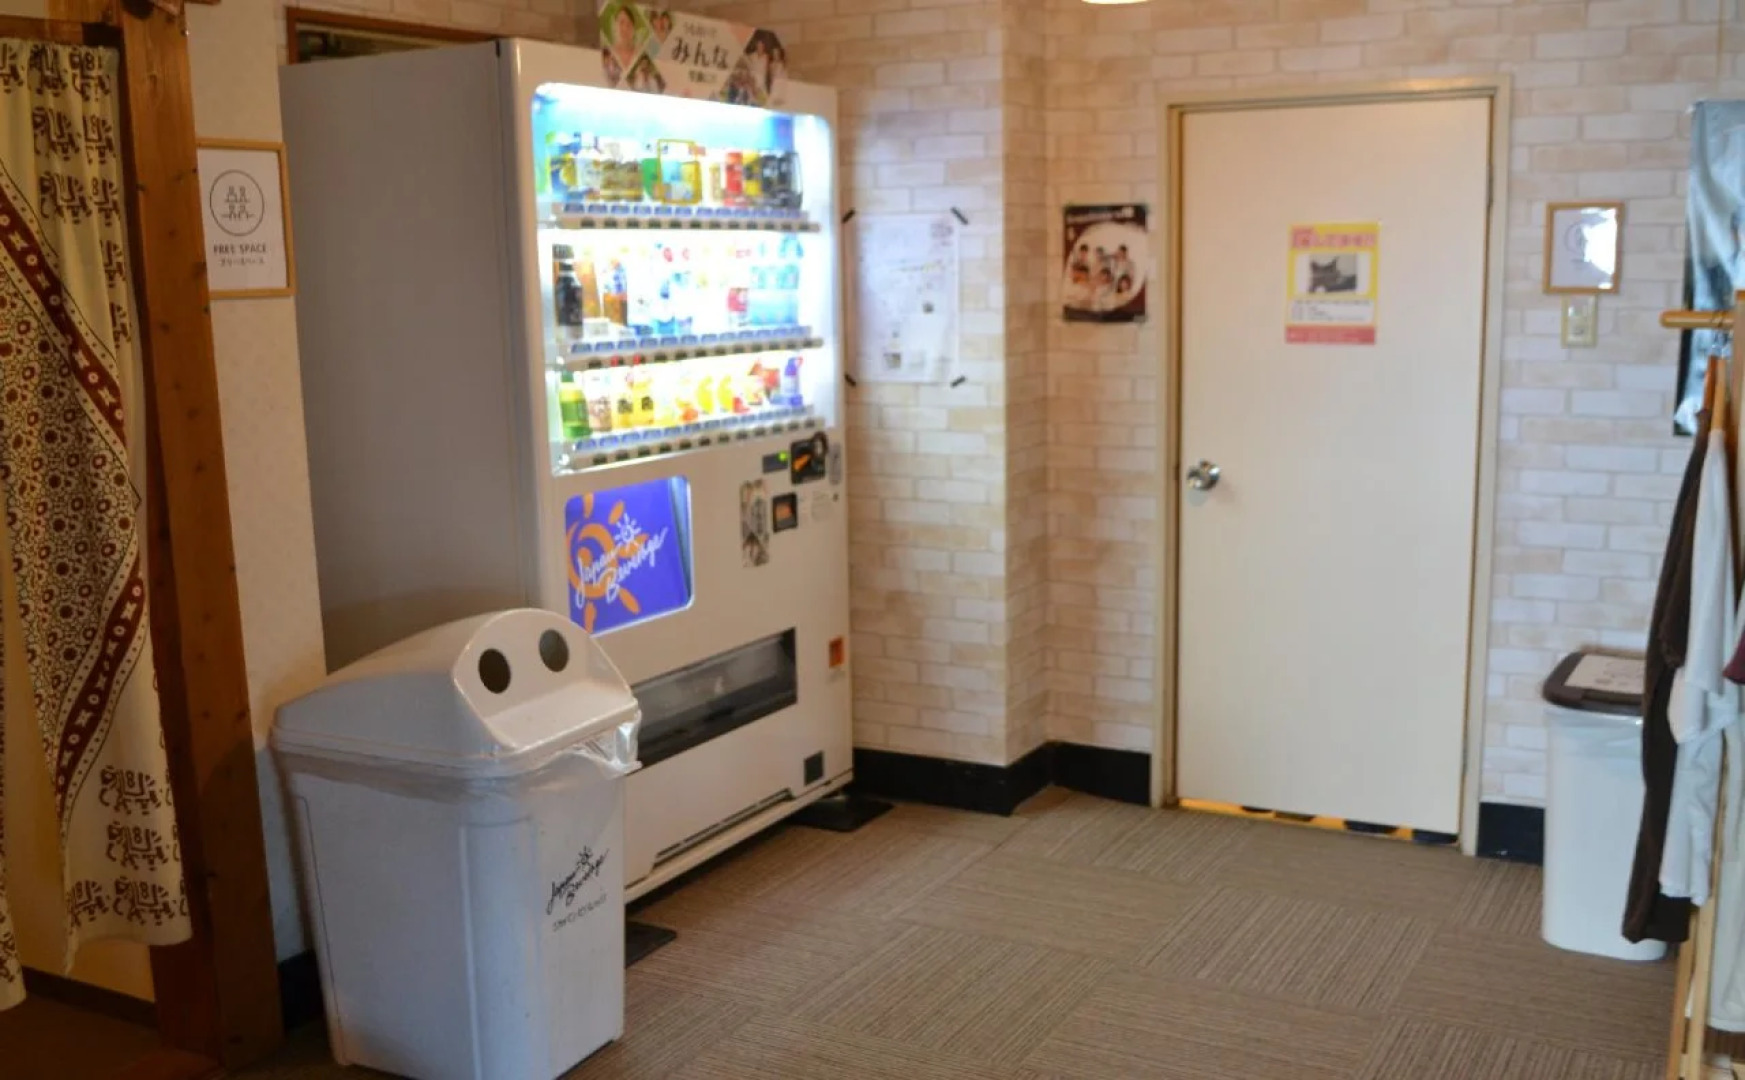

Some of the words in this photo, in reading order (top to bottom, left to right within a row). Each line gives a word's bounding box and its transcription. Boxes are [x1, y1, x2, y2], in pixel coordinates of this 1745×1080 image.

[671, 37, 729, 69] みんな
[213, 243, 235, 255] FREE
[239, 243, 267, 254] SPACE
